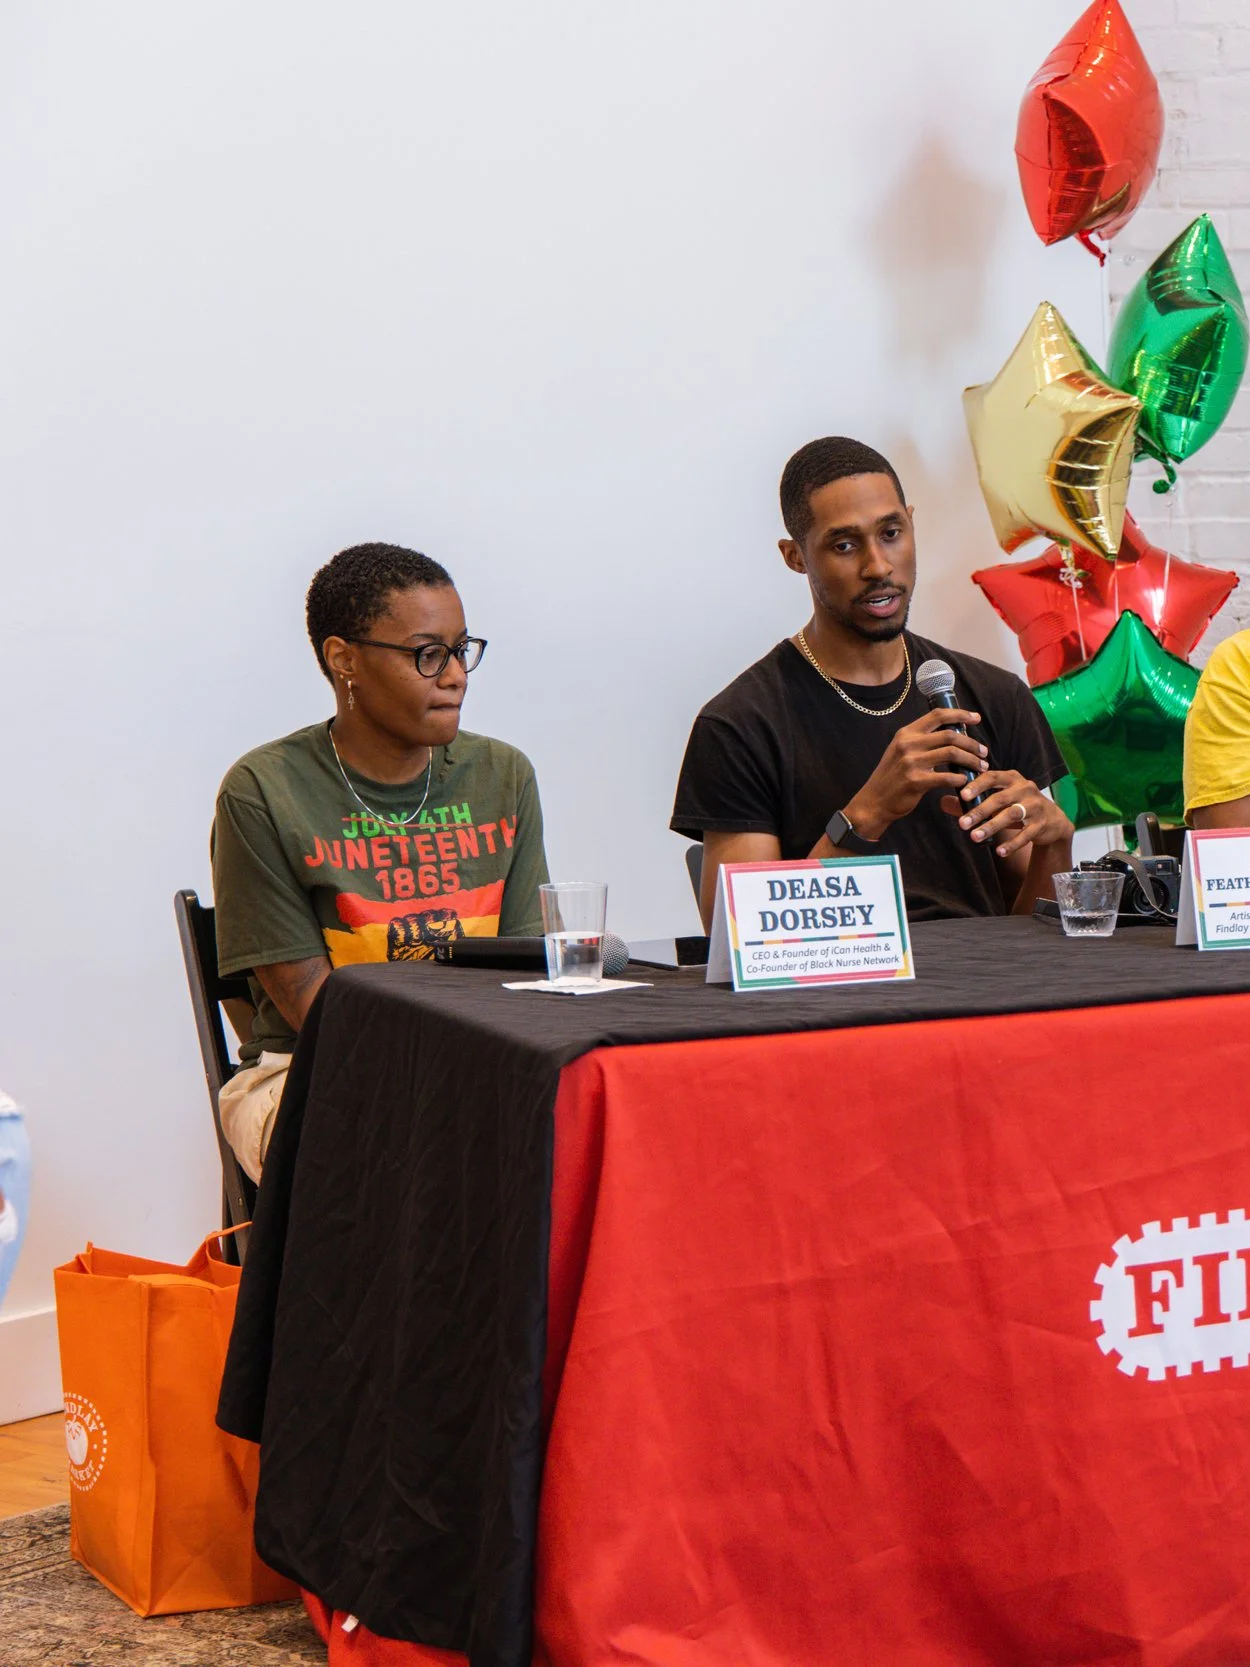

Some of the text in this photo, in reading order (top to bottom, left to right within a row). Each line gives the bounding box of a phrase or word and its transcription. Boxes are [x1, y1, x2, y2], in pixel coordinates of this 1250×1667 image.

[342, 802, 473, 838] JULY 4TH
[305, 815, 517, 870] JUNETEENTH
[375, 862, 461, 900] 1865
[767, 875, 862, 901] DEASA
[759, 904, 875, 932] DORSEY
[1216, 923, 1249, 934] Findlay
[746, 955, 901, 974] Co-Founder of Black Nurse Network
[752, 943, 891, 961] CEO & Founder of iCan Health &
